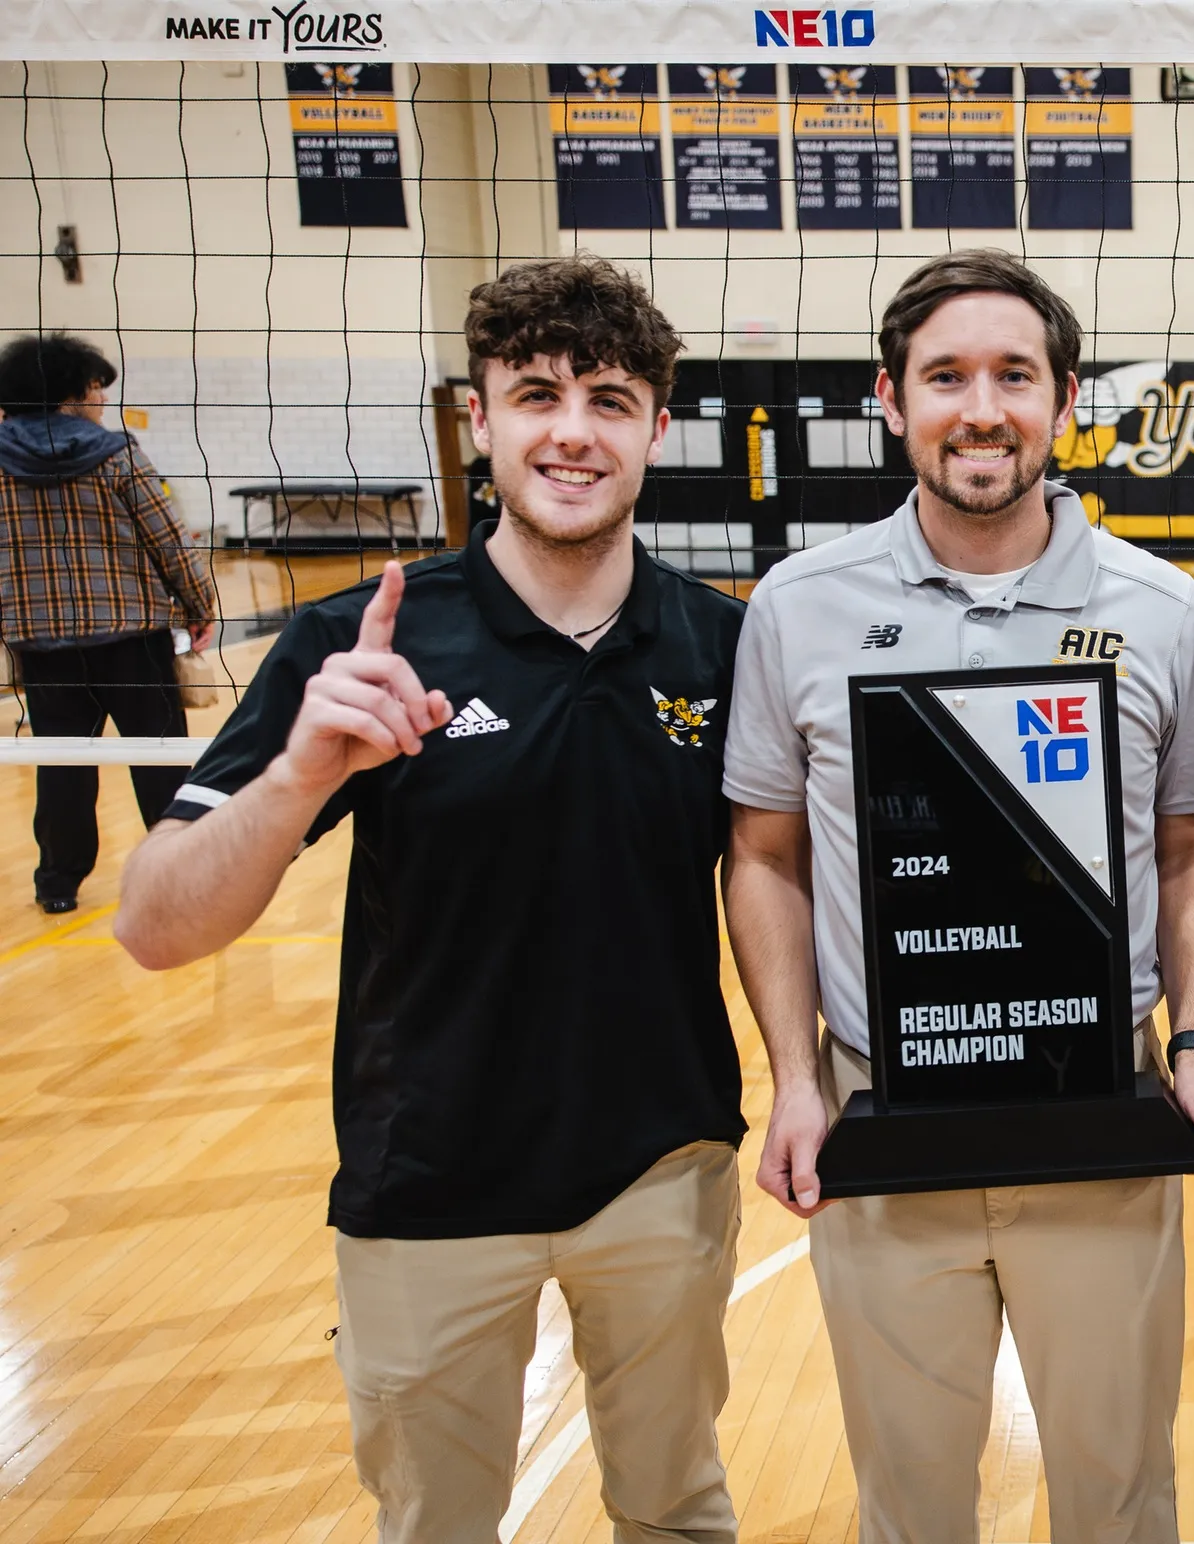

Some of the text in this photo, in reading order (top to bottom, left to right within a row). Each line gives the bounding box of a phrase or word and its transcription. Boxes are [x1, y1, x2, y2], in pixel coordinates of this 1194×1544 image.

[166, 17, 240, 39] MAKE
[249, 19, 272, 39] IT
[754, 9, 875, 47] NE10
[572, 109, 637, 121] BASEBALL
[1059, 626, 1125, 662] AIC
[445, 716, 510, 738] adidas
[1016, 697, 1090, 736] NE
[1019, 737, 1090, 784] 10
[892, 855, 950, 877] 2024
[895, 925, 1022, 954] VOLLEYBALL
[900, 997, 1098, 1034] REGULAR SEASON
[901, 1034, 1024, 1067] CHAMPION
